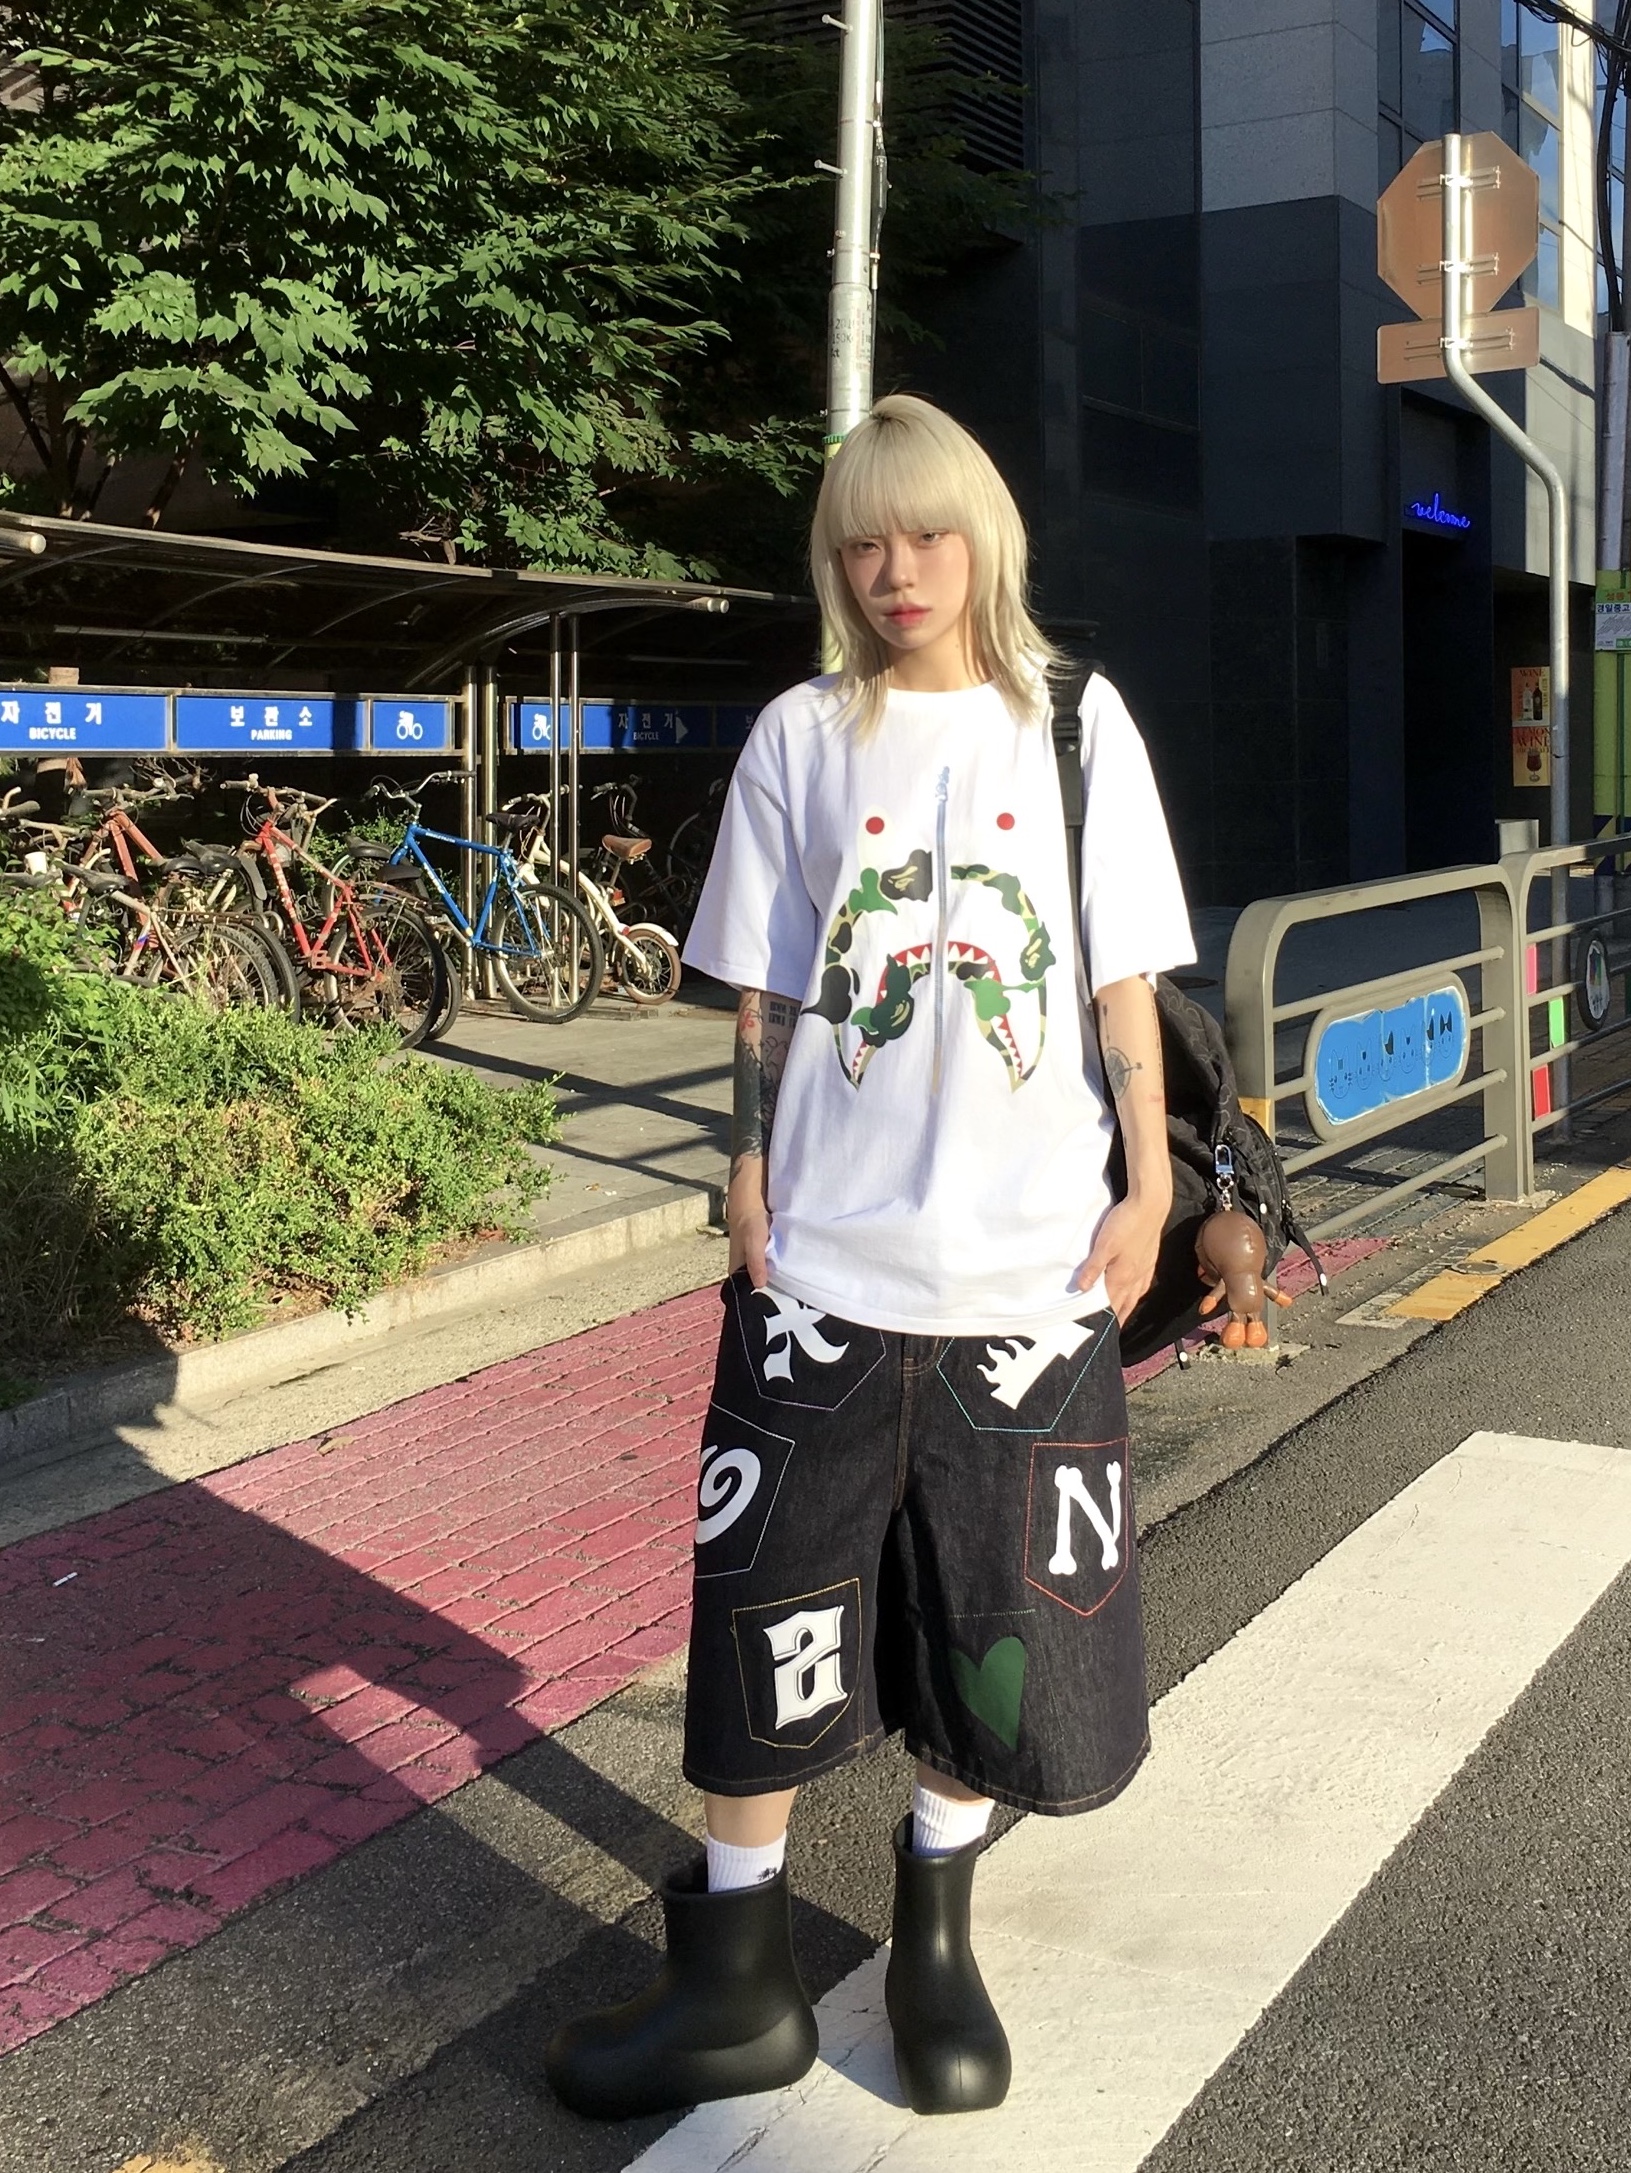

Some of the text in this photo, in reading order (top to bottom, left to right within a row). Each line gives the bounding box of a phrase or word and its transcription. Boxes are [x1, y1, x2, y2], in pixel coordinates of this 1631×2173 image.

[1411, 493, 1470, 528] welcome
[29, 727, 77, 740] BICYCLE
[251, 729, 293, 741] PARKING
[633, 731, 659, 741] BICYCLE
[1047, 1461, 1122, 1575] N
